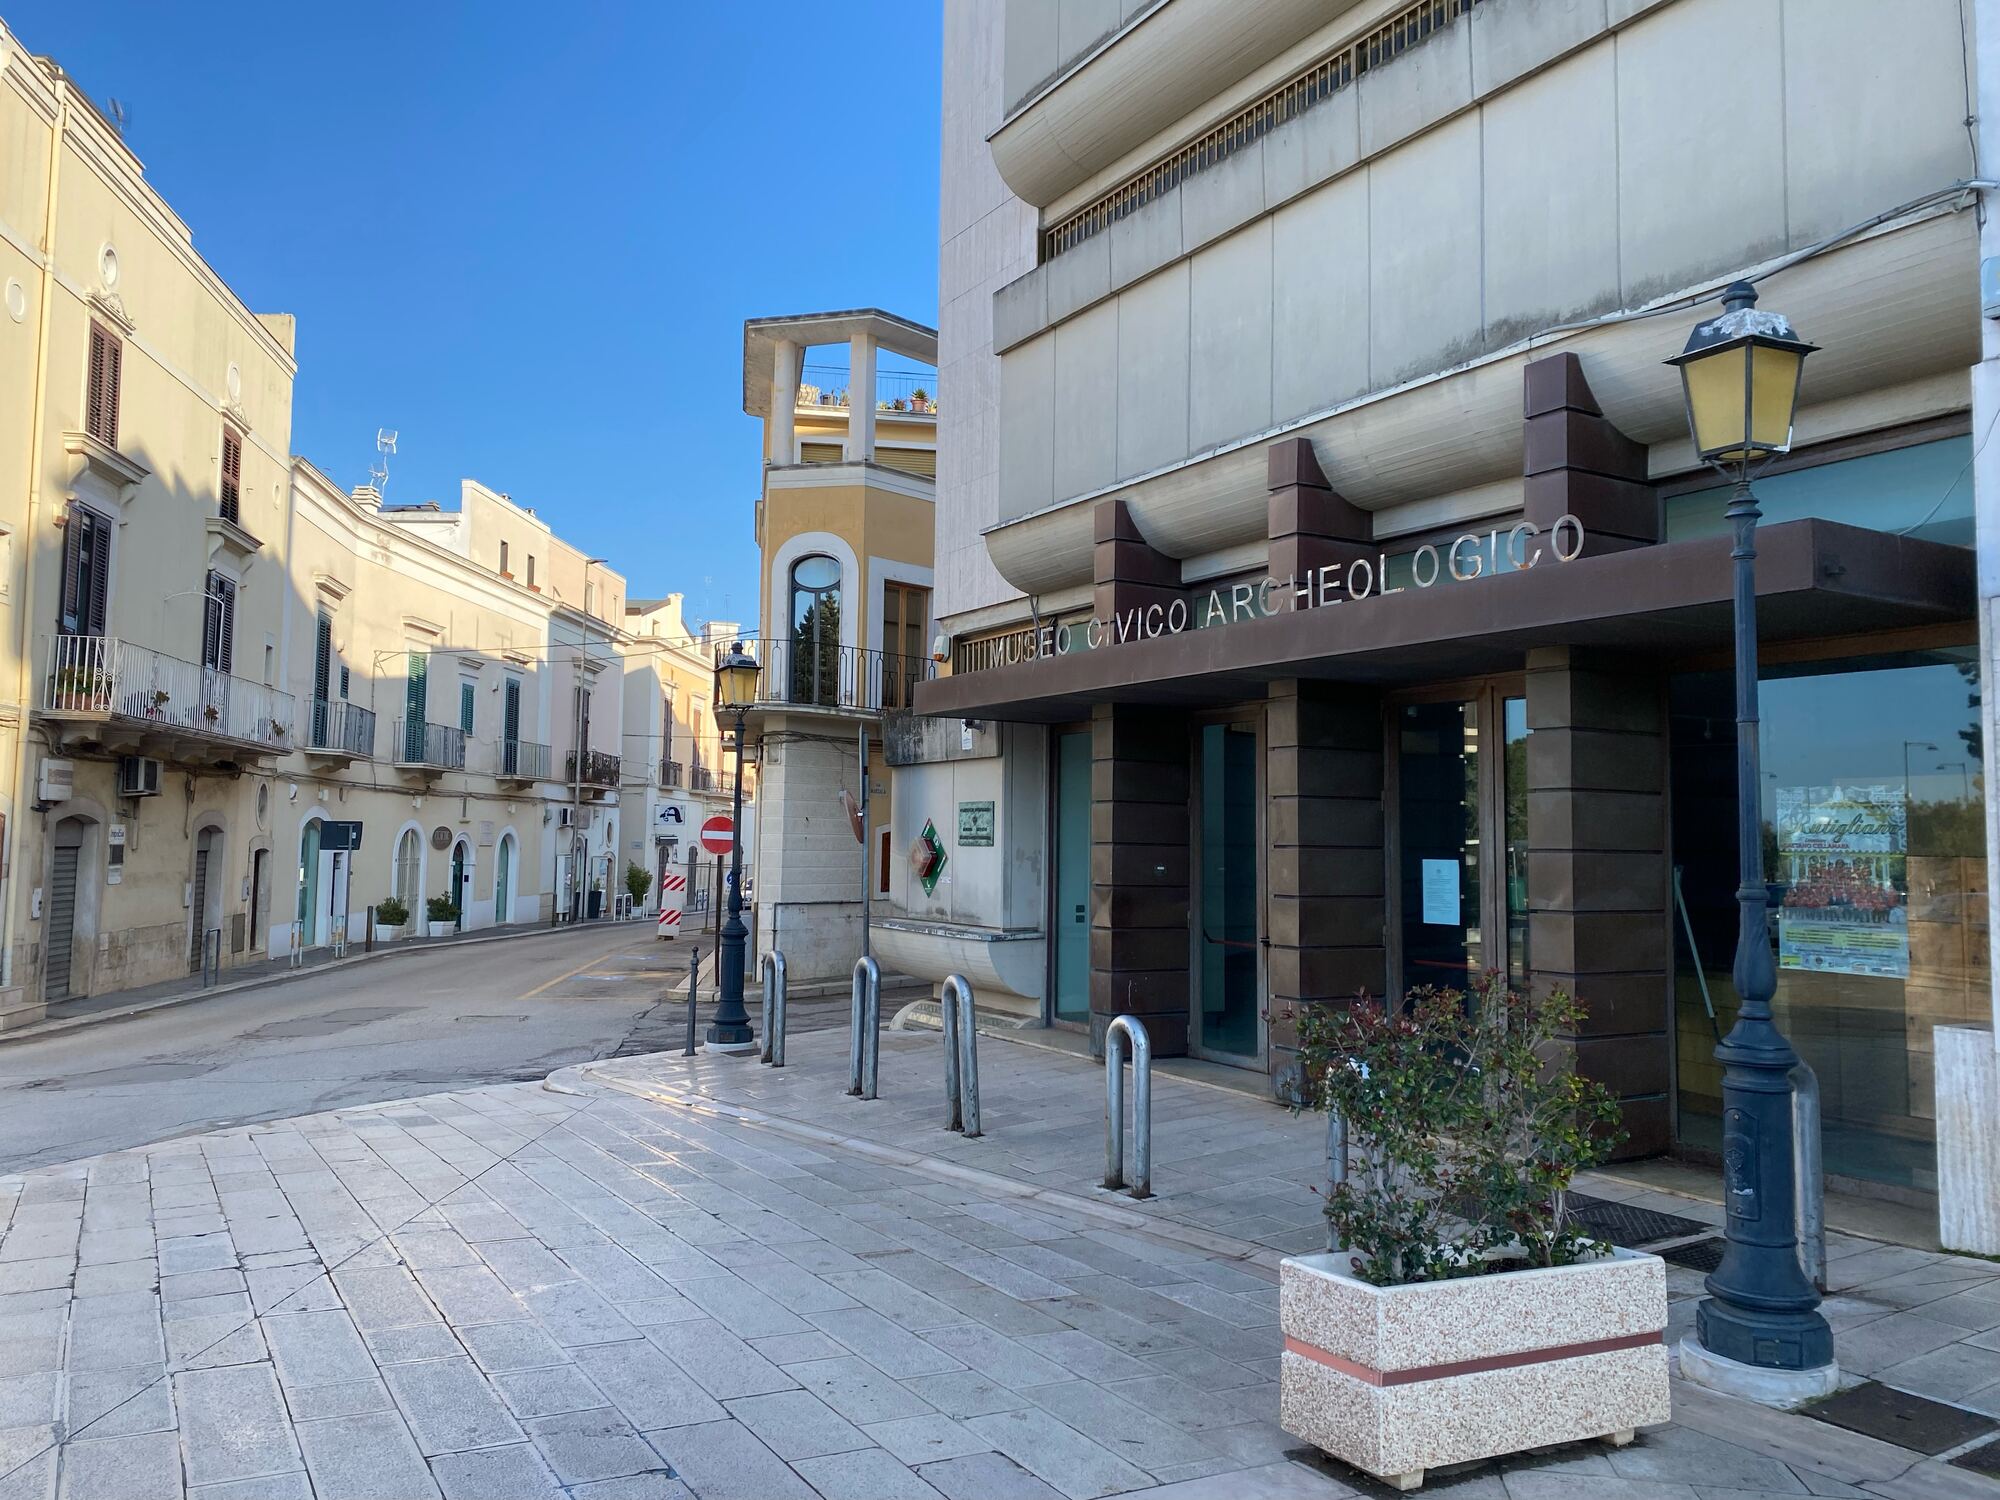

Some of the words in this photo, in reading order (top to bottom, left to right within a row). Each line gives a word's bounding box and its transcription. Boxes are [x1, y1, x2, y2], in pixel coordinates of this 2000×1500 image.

[990, 624, 1071, 668] MUSEO
[1087, 598, 1187, 649] CIVICO
[1206, 513, 1585, 627] ARCHEOLOGICO
